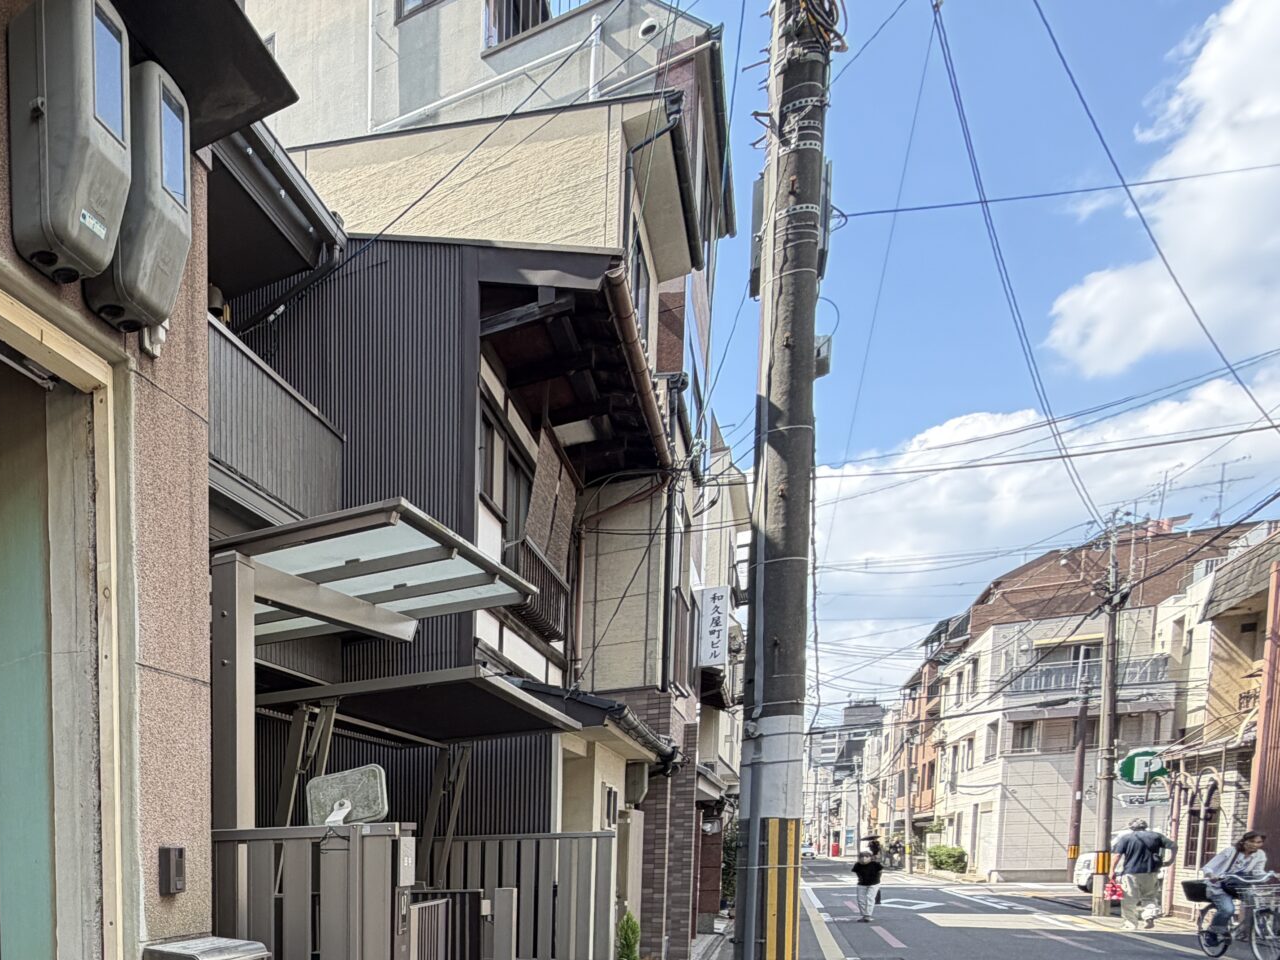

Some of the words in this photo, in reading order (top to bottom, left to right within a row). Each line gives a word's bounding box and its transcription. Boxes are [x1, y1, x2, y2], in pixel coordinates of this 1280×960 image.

[709, 592, 724, 659] 和久屋町ビル
[1133, 756, 1163, 781] P
